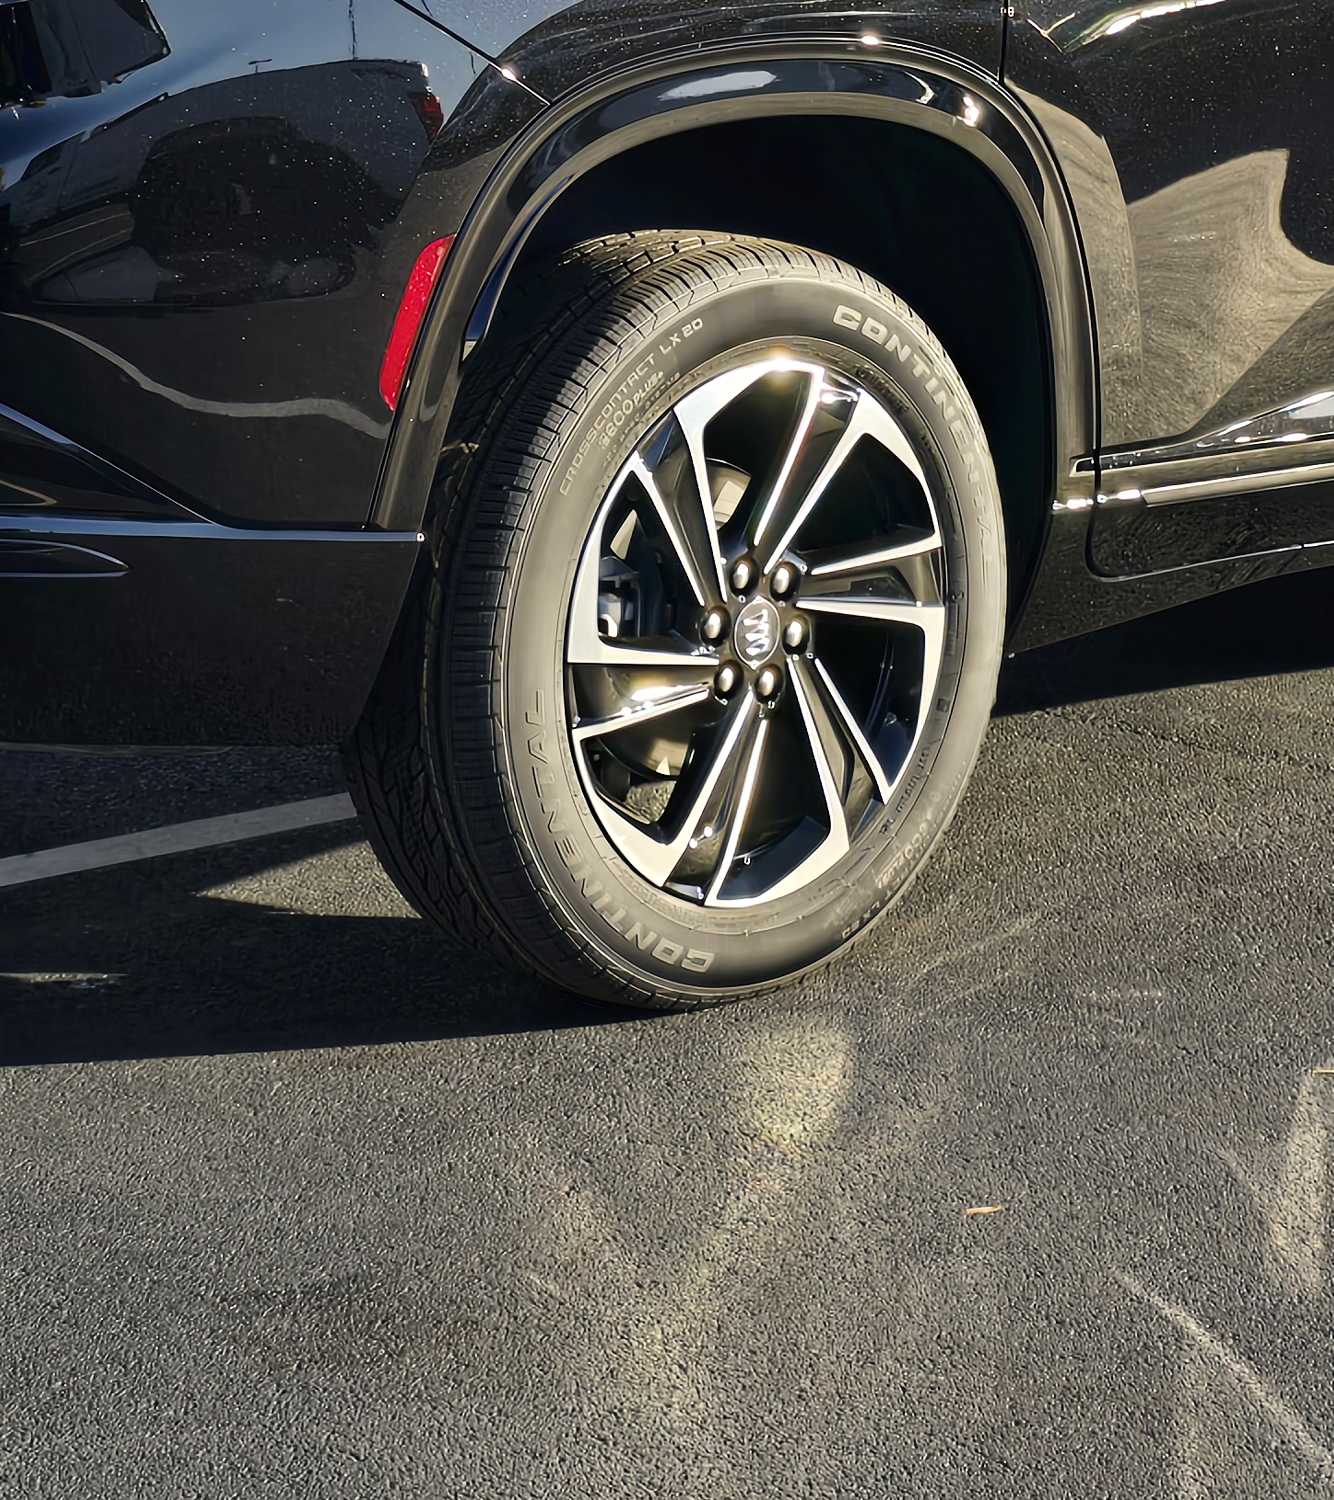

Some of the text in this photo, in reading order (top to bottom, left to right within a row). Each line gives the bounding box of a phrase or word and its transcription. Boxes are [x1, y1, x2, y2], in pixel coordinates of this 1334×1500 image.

[560, 317, 704, 496] CROSSCONTACT LX 20
[832, 304, 994, 585] CONTINENTAL
[525, 690, 716, 973] CONTINENTAL
